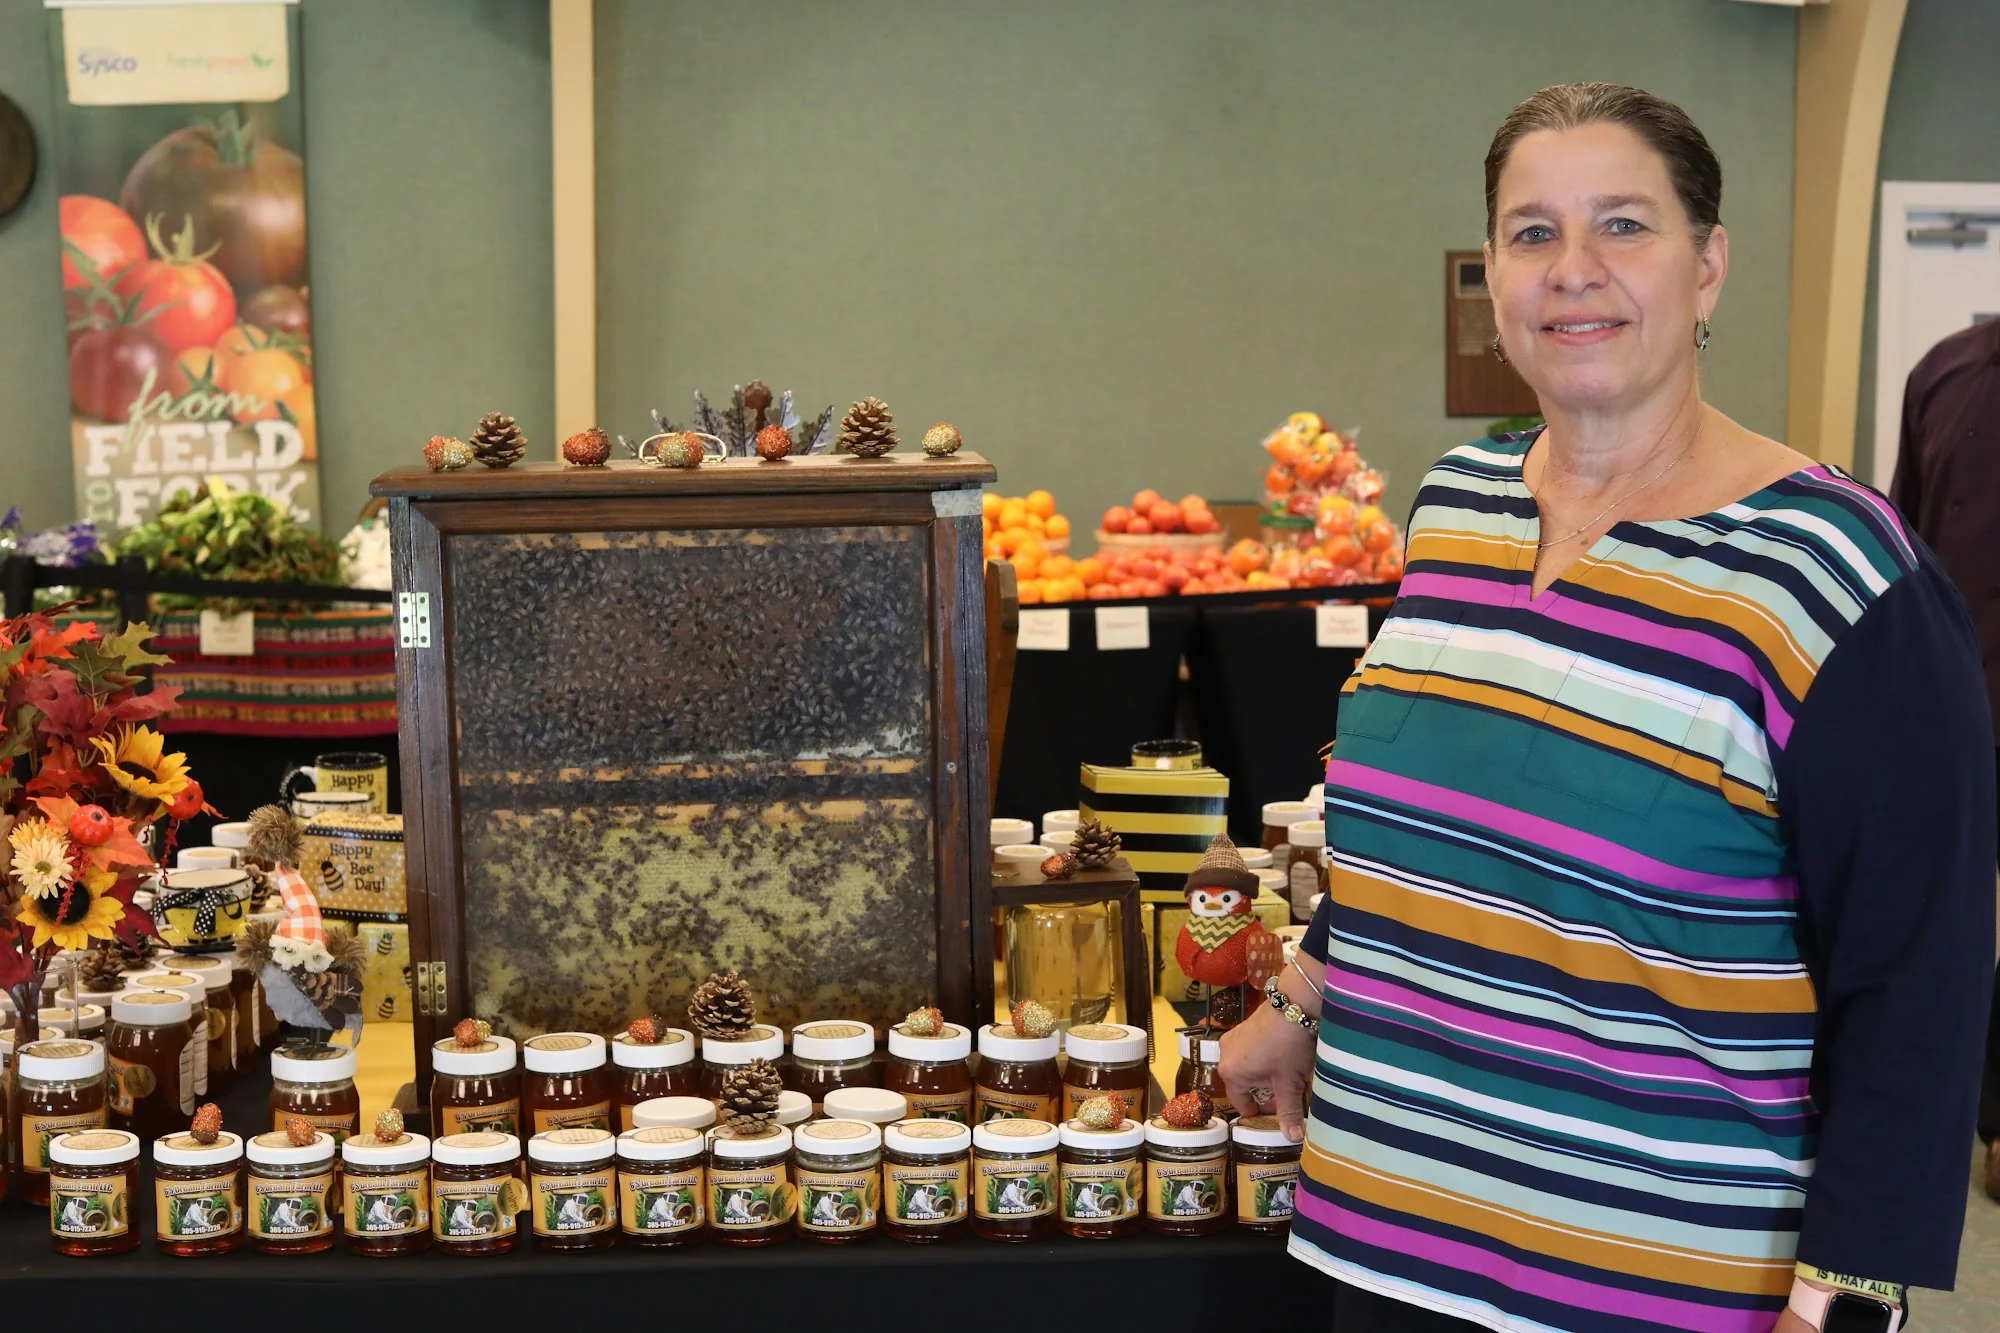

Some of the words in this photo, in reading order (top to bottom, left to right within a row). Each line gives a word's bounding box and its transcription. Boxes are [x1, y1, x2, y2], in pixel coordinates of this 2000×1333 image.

[77, 52, 138, 78] Sysco
[121, 366, 268, 454] from
[84, 419, 304, 477] FIELD
[332, 773, 375, 790] Happy
[329, 843, 374, 861] Happy
[350, 862, 375, 875] Bee
[354, 877, 386, 893] Day!
[1038, 1161, 1050, 1173] LLC
[760, 1172, 776, 1184] LLC
[946, 1168, 960, 1180] LLC
[1111, 1168, 1127, 1179] LLC
[405, 1178, 419, 1190] LLC
[596, 1176, 609, 1188] LLC
[687, 1174, 698, 1186] LLC
[851, 1176, 867, 1188] LLC
[98, 1182, 114, 1193] LLC
[311, 1182, 325, 1193] LLC
[486, 1183, 501, 1194] LLC
[998, 1205, 1037, 1214] 305-915-7226
[1074, 1209, 1112, 1218] 305-915-7226
[1172, 1206, 1211, 1216] 305-915-7226
[1268, 1208, 1293, 1217] 305-915-
[724, 1215, 762, 1225] 305-915-7226
[906, 1211, 945, 1220] 305-915-7226
[366, 1222, 405, 1231] 305-915-7226
[557, 1220, 596, 1230] 305-915-7226
[647, 1219, 686, 1229] 305-915-7226
[812, 1218, 850, 1226] 305-915-7226
[60, 1224, 96, 1232] 305-915-7226
[181, 1224, 221, 1235] 305-915-7226
[269, 1225, 309, 1234] 305-915-7226
[449, 1227, 487, 1236] 305-915-7226
[1816, 1268, 1829, 1279] IS
[1832, 1273, 1867, 1289] THAT
[1868, 1281, 1889, 1296] ALL
